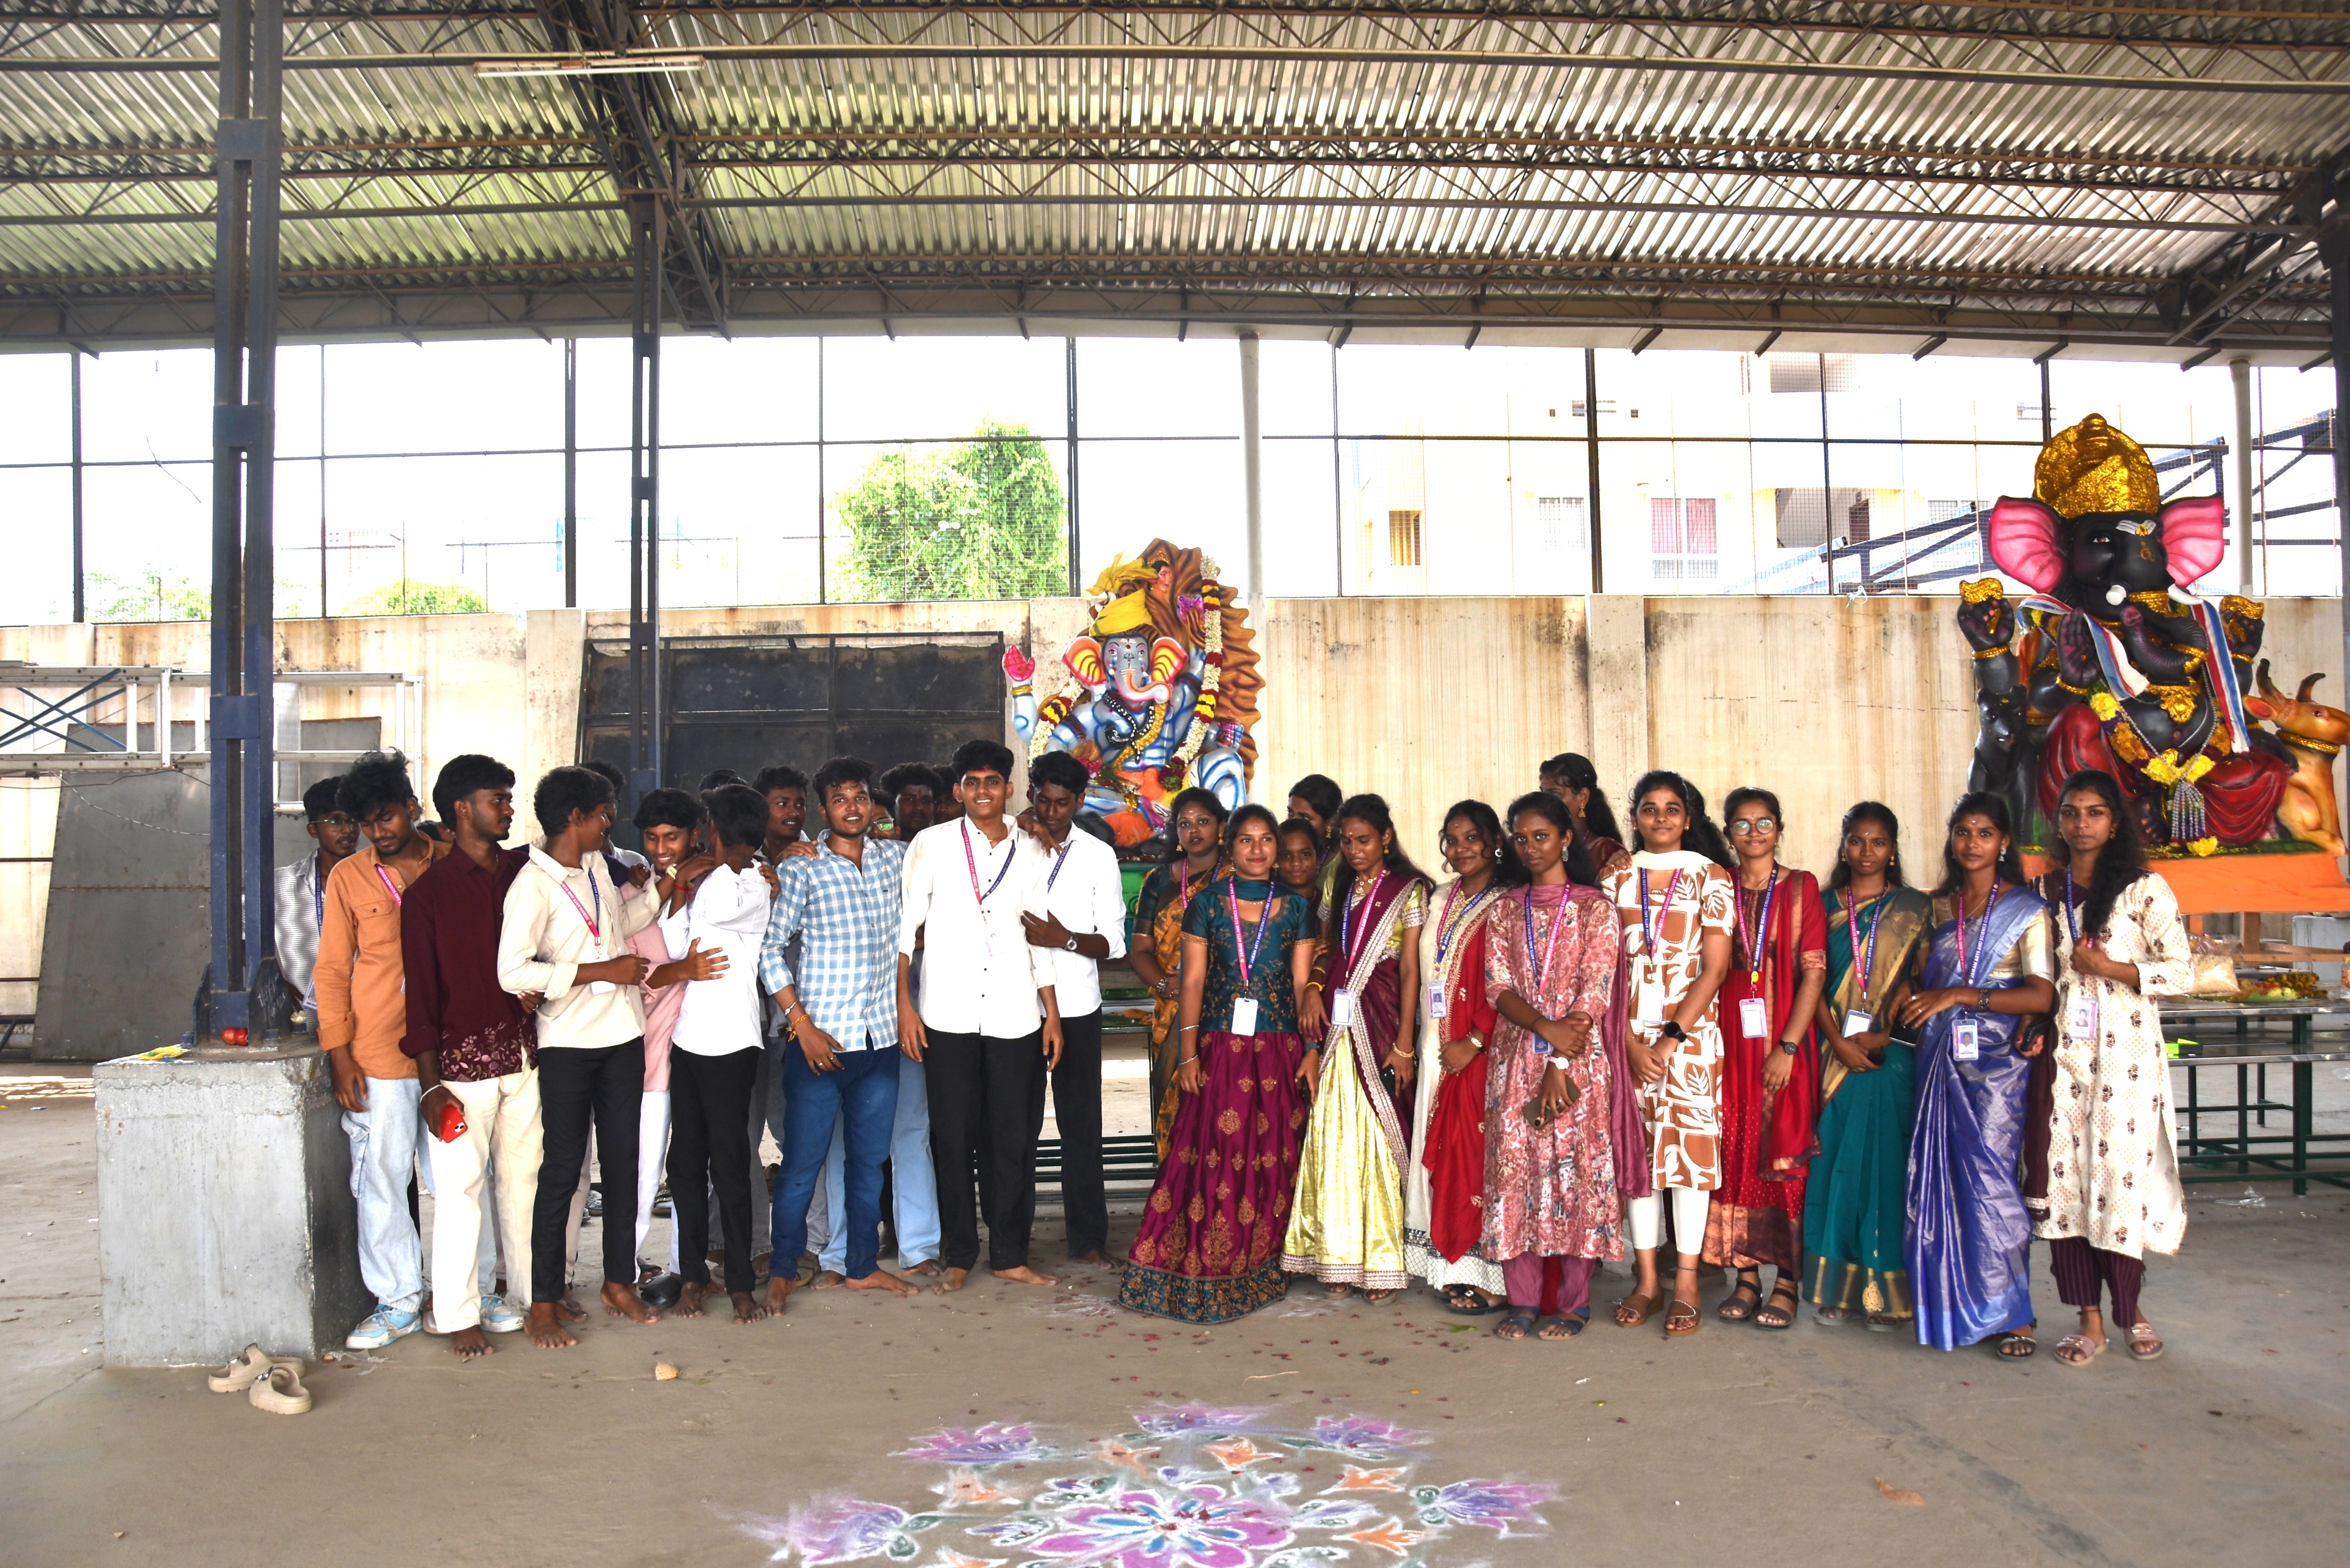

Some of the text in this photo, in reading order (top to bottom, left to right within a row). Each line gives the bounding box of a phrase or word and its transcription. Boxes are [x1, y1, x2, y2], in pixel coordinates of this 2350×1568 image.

[1055, 857, 1064, 869] SCIENCE
[386, 879, 396, 893] SCIENCE
[990, 881, 999, 892] JAIRAM
[1472, 893, 1483, 904] COLLEGE
[579, 907, 589, 920] JAIRAM
